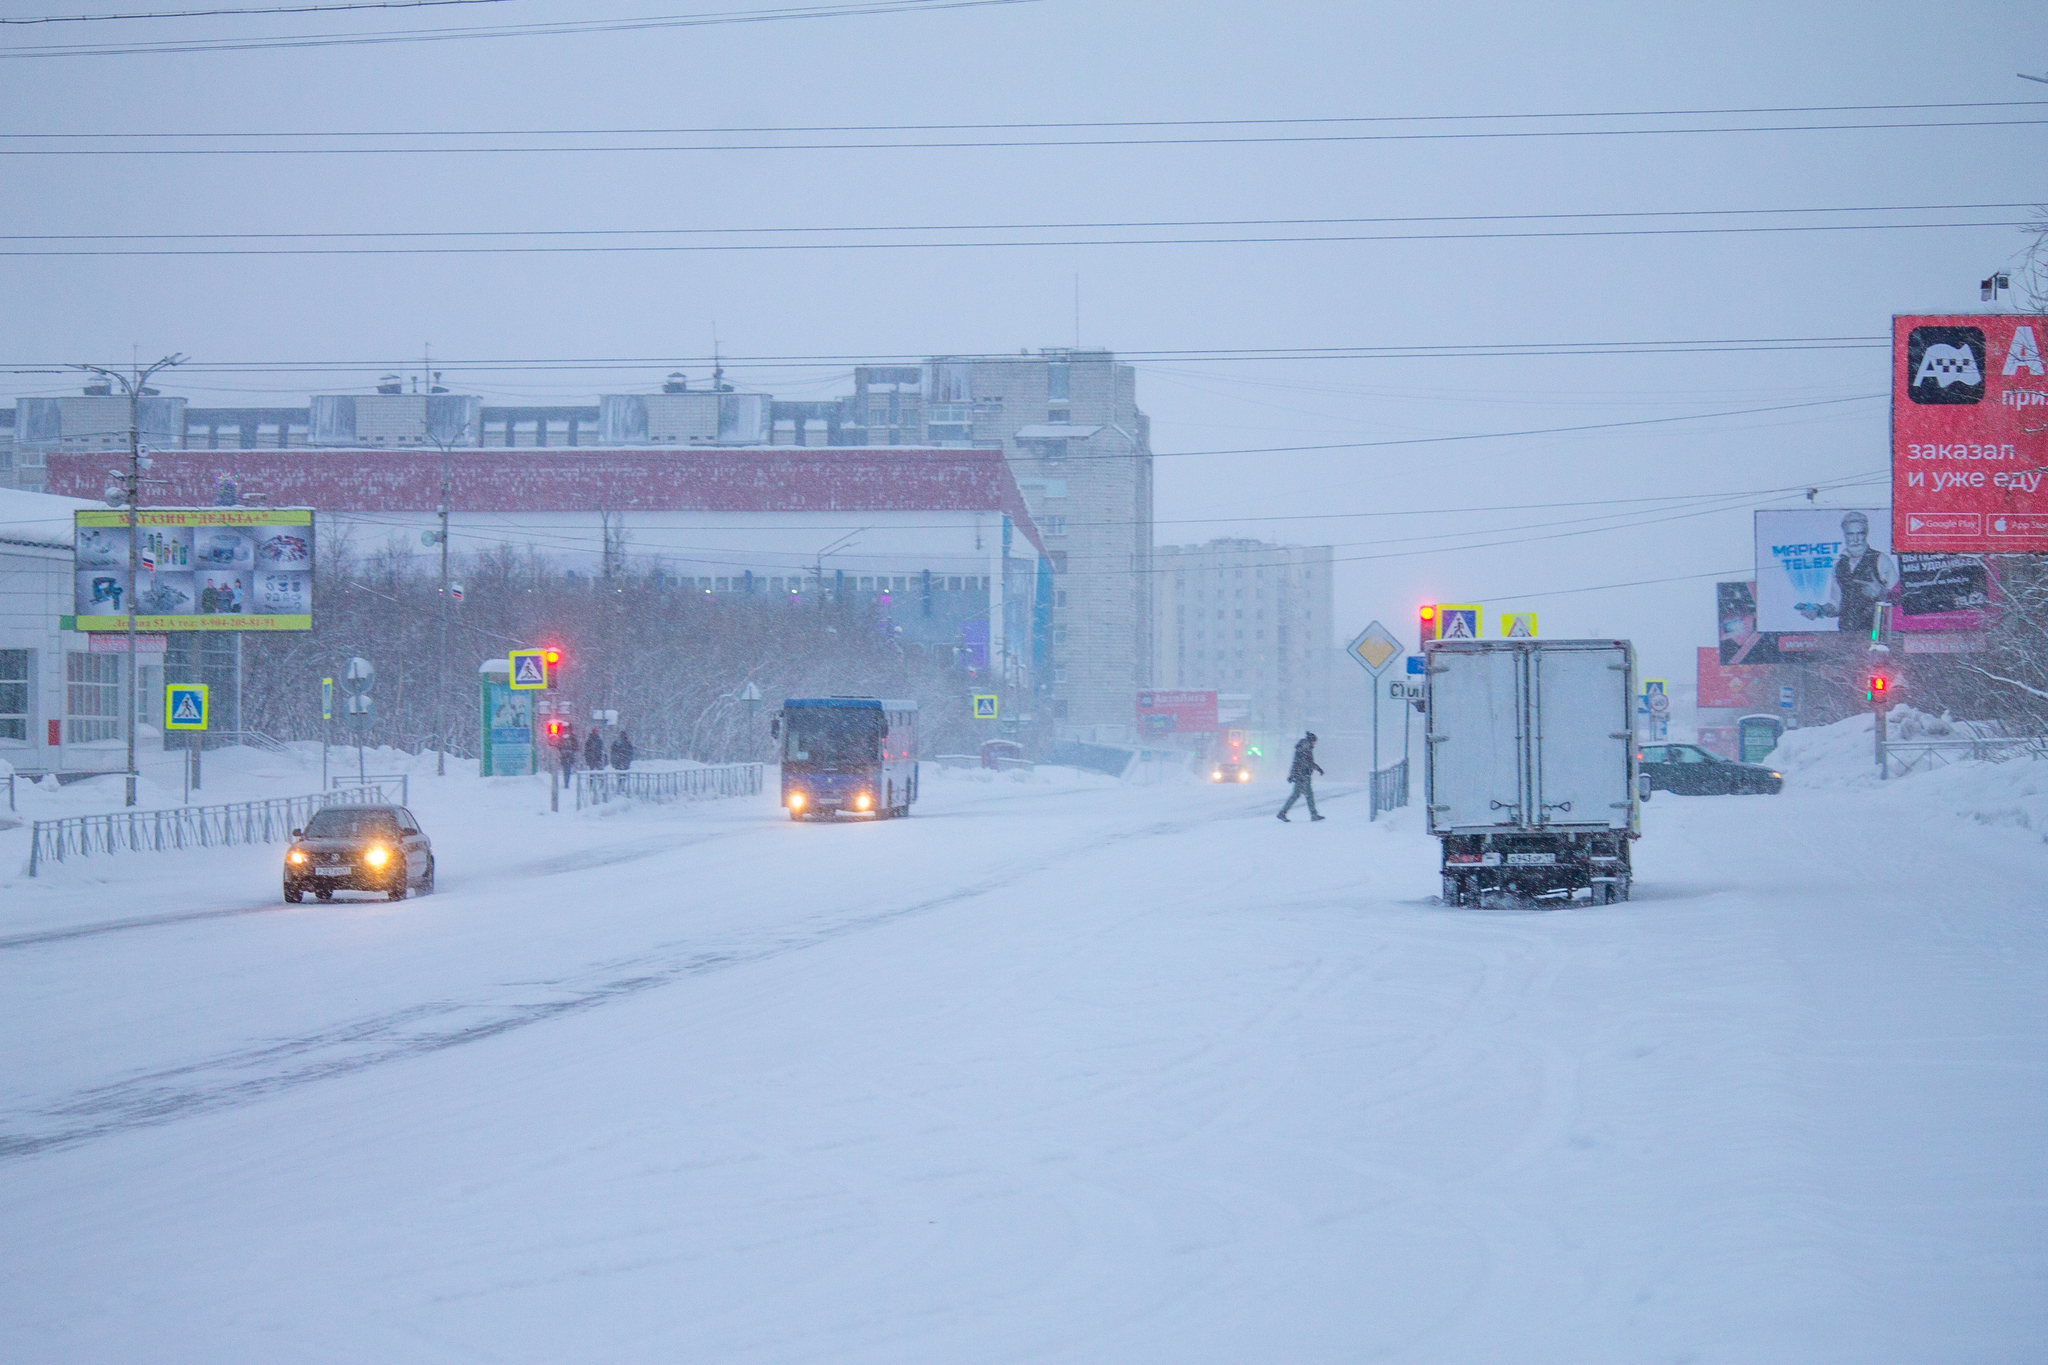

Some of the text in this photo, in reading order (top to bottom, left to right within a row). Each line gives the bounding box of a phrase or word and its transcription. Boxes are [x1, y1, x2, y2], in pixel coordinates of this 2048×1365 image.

[2002, 390, 2048, 411] при
[1907, 444, 2015, 460] заказал
[1908, 471, 2042, 493] и уже еду
[1926, 520, 1977, 530] Google Play
[1772, 542, 1842, 557] МАРКЕТ
